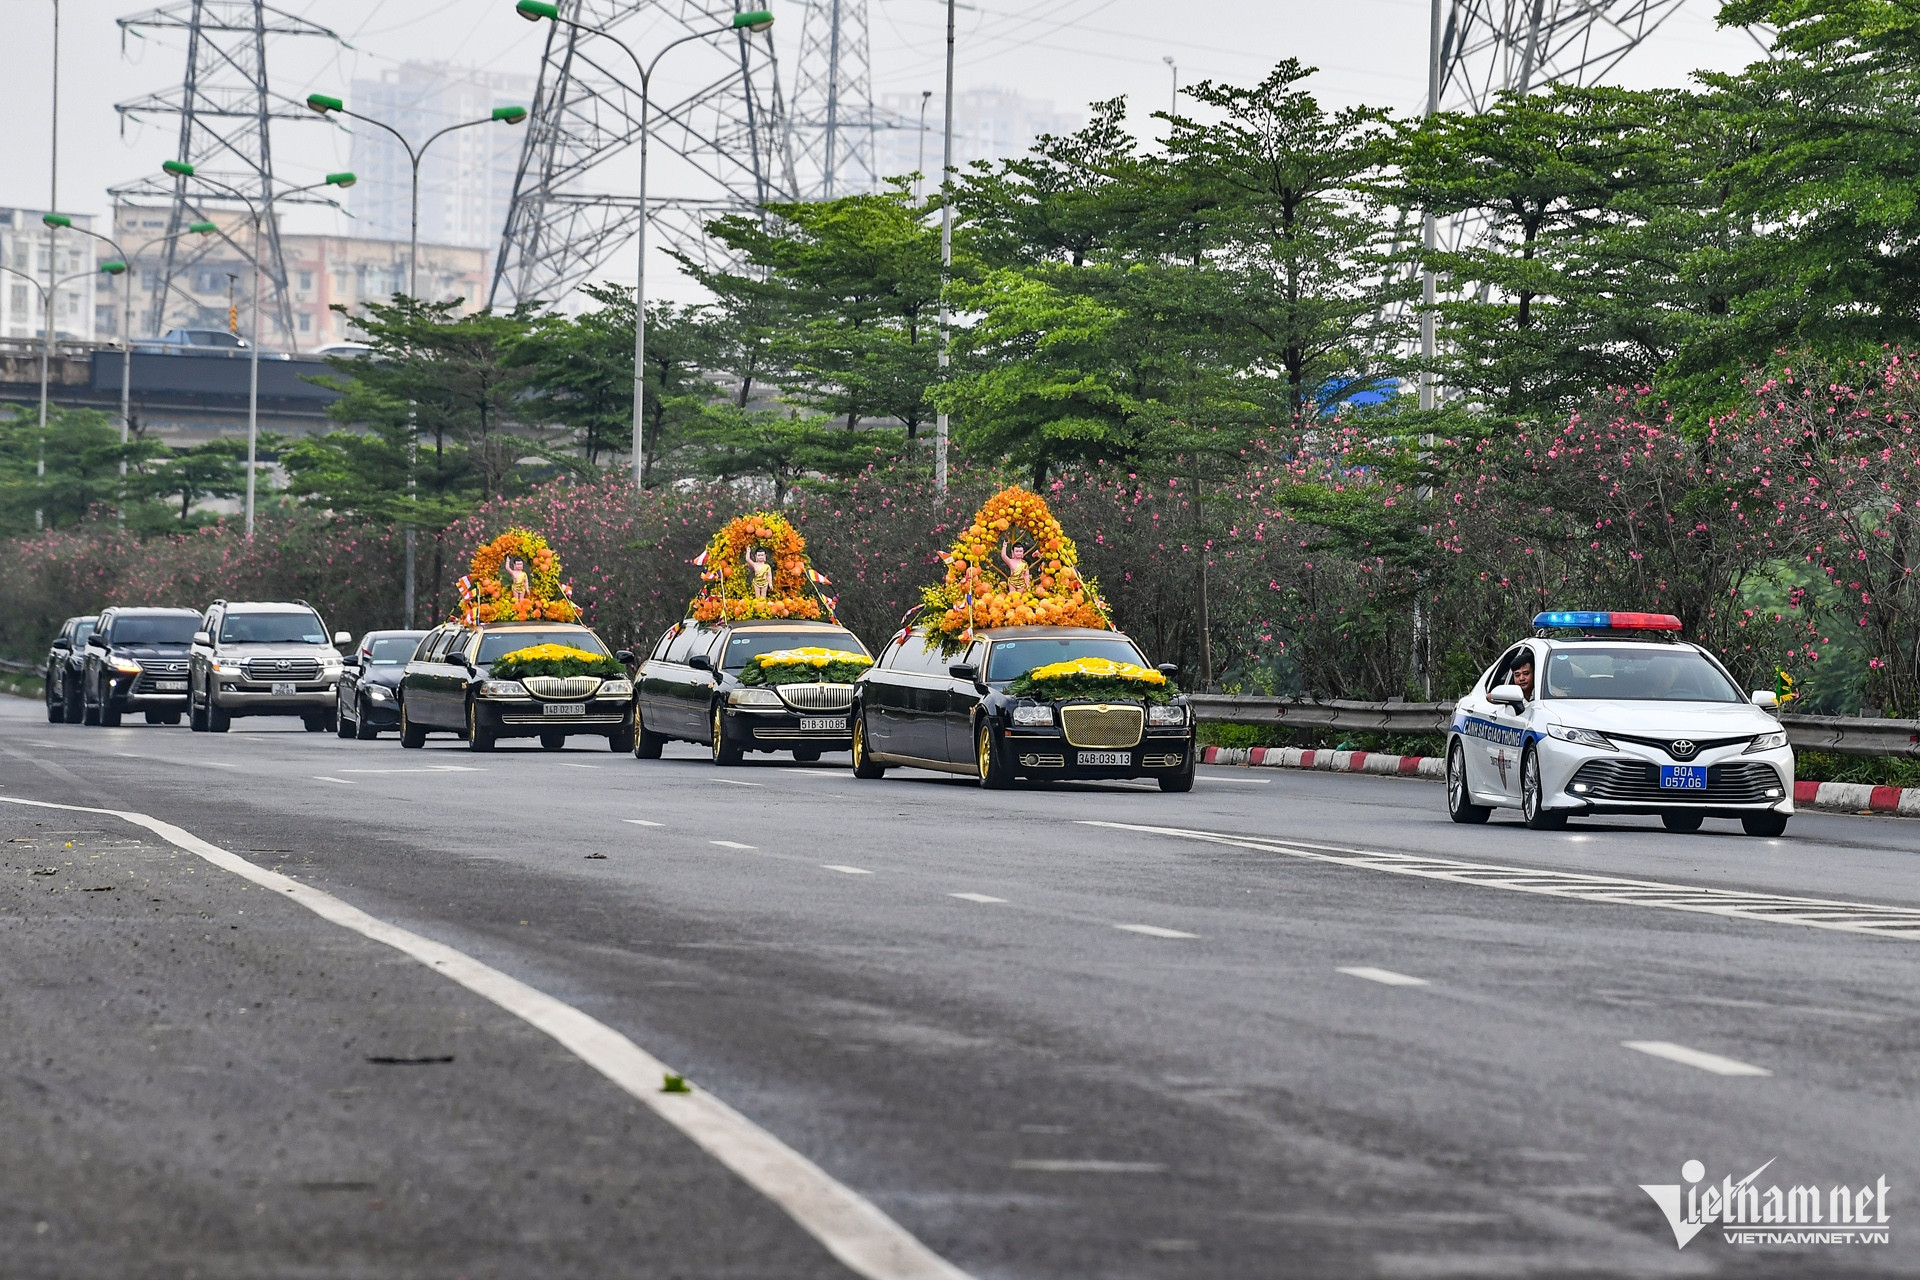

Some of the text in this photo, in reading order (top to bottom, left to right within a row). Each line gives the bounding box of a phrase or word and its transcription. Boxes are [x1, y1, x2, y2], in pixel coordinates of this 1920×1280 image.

[801, 720, 845, 729] 51B-310.85
[1487, 725, 1501, 742] GIAO
[1078, 753, 1130, 764] 34B-039.13
[1673, 766, 1694, 777] 80A
[1665, 777, 1702, 788] 057.06
